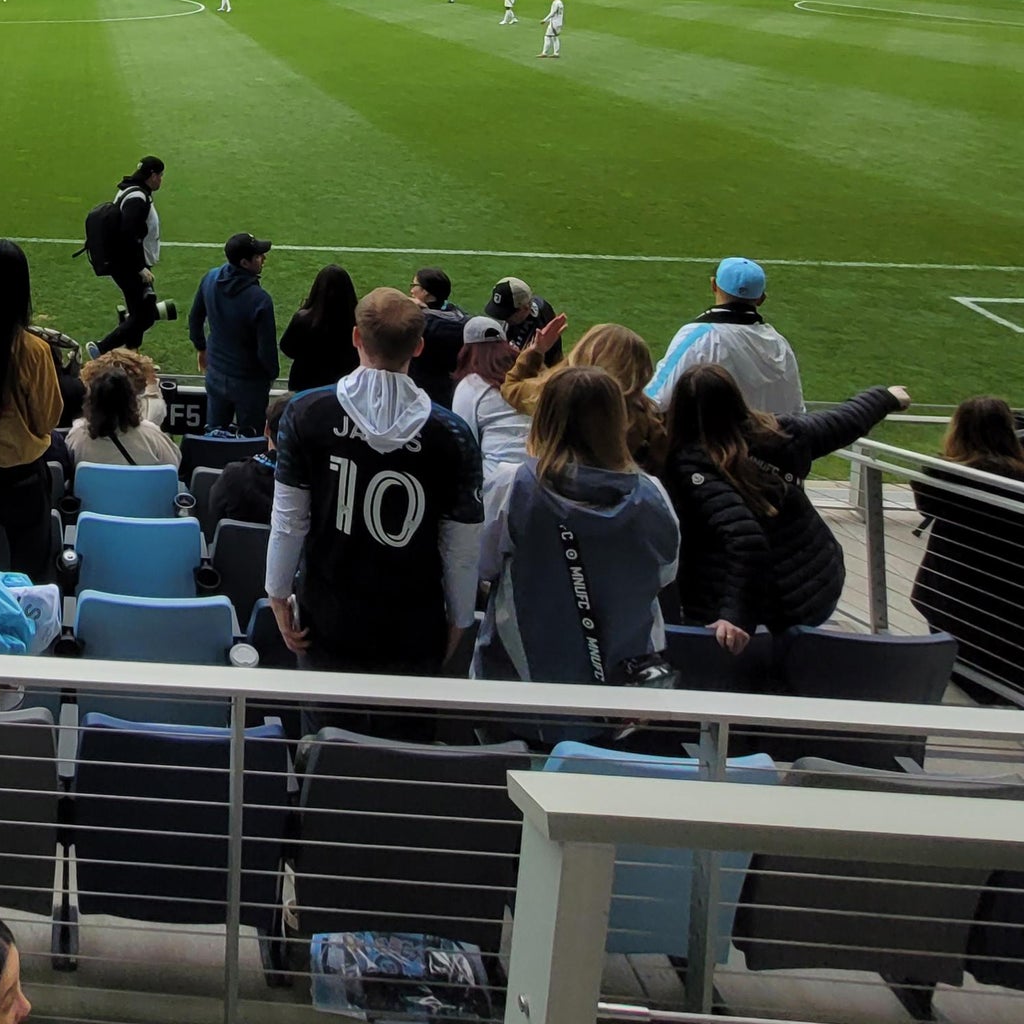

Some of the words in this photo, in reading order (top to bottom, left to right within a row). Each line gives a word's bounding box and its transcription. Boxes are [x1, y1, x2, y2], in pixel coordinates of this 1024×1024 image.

[333, 415, 423, 453] JAS
[329, 454, 426, 548] 10
[569, 566, 591, 611] MNUFC
[586, 636, 606, 683] MNUFC
